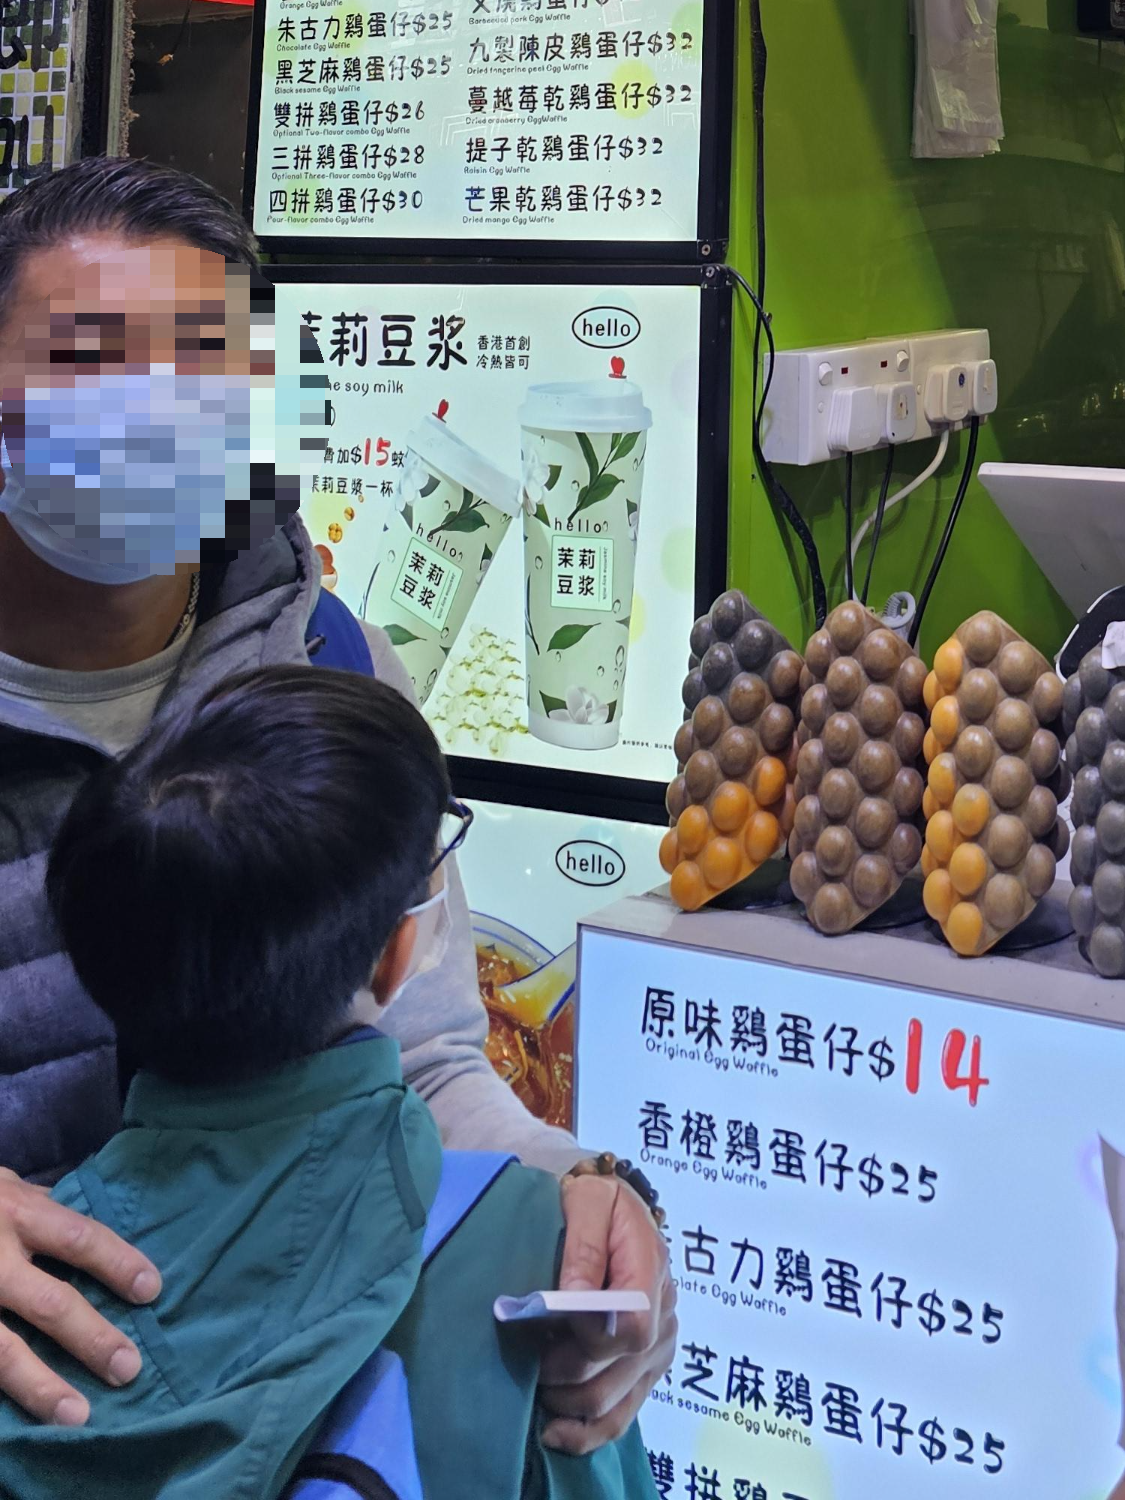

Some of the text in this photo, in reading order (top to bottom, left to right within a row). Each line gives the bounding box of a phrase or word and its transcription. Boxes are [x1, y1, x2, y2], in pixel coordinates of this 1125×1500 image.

[477, 335, 531, 351] 香港首創
[582, 317, 632, 338] hello
[476, 354, 531, 370] 冷熱皆可
[345, 381, 370, 396] soy
[373, 379, 404, 394] milk
[415, 522, 457, 558] hello
[555, 518, 602, 534] hello
[408, 550, 445, 587] 茉莉
[557, 546, 596, 570] 茉莉
[399, 573, 437, 610] 豆浆
[556, 574, 595, 596] 豆浆
[566, 850, 616, 876] hello
[645, 1037, 779, 1078] Original Egg Waffle
[640, 1147, 767, 1190] Orange Egg Waffle
[663, 1224, 1004, 1345] 古力鷄蛋仔$25
[711, 1283, 787, 1316] Egg Waffle
[663, 1341, 1006, 1475] 芝麻鷄蛋仔$25
[677, 1397, 812, 1446] sesame Egg Waffle
